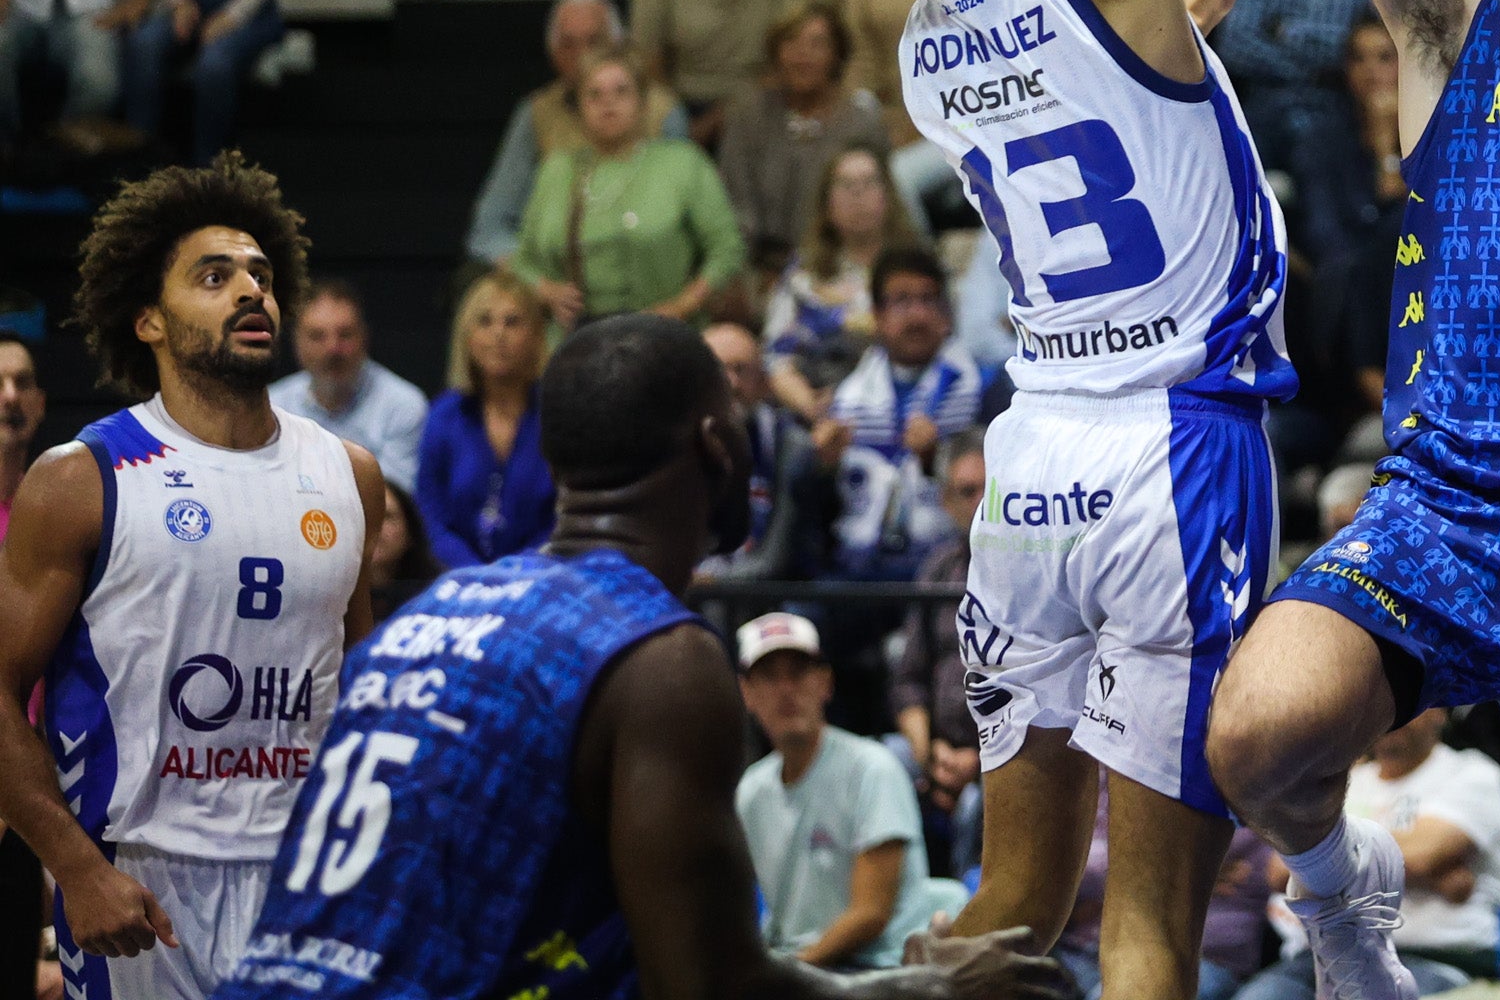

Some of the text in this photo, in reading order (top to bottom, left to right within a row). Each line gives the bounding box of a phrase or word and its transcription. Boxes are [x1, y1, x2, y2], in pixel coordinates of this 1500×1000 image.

[960, 118, 1167, 308] 13
[237, 556, 285, 621] 8
[1311, 561, 1408, 629] ALIMERKA
[251, 666, 313, 722] HLA
[160, 745, 311, 780] ALICANTE
[286, 730, 420, 897] 15
